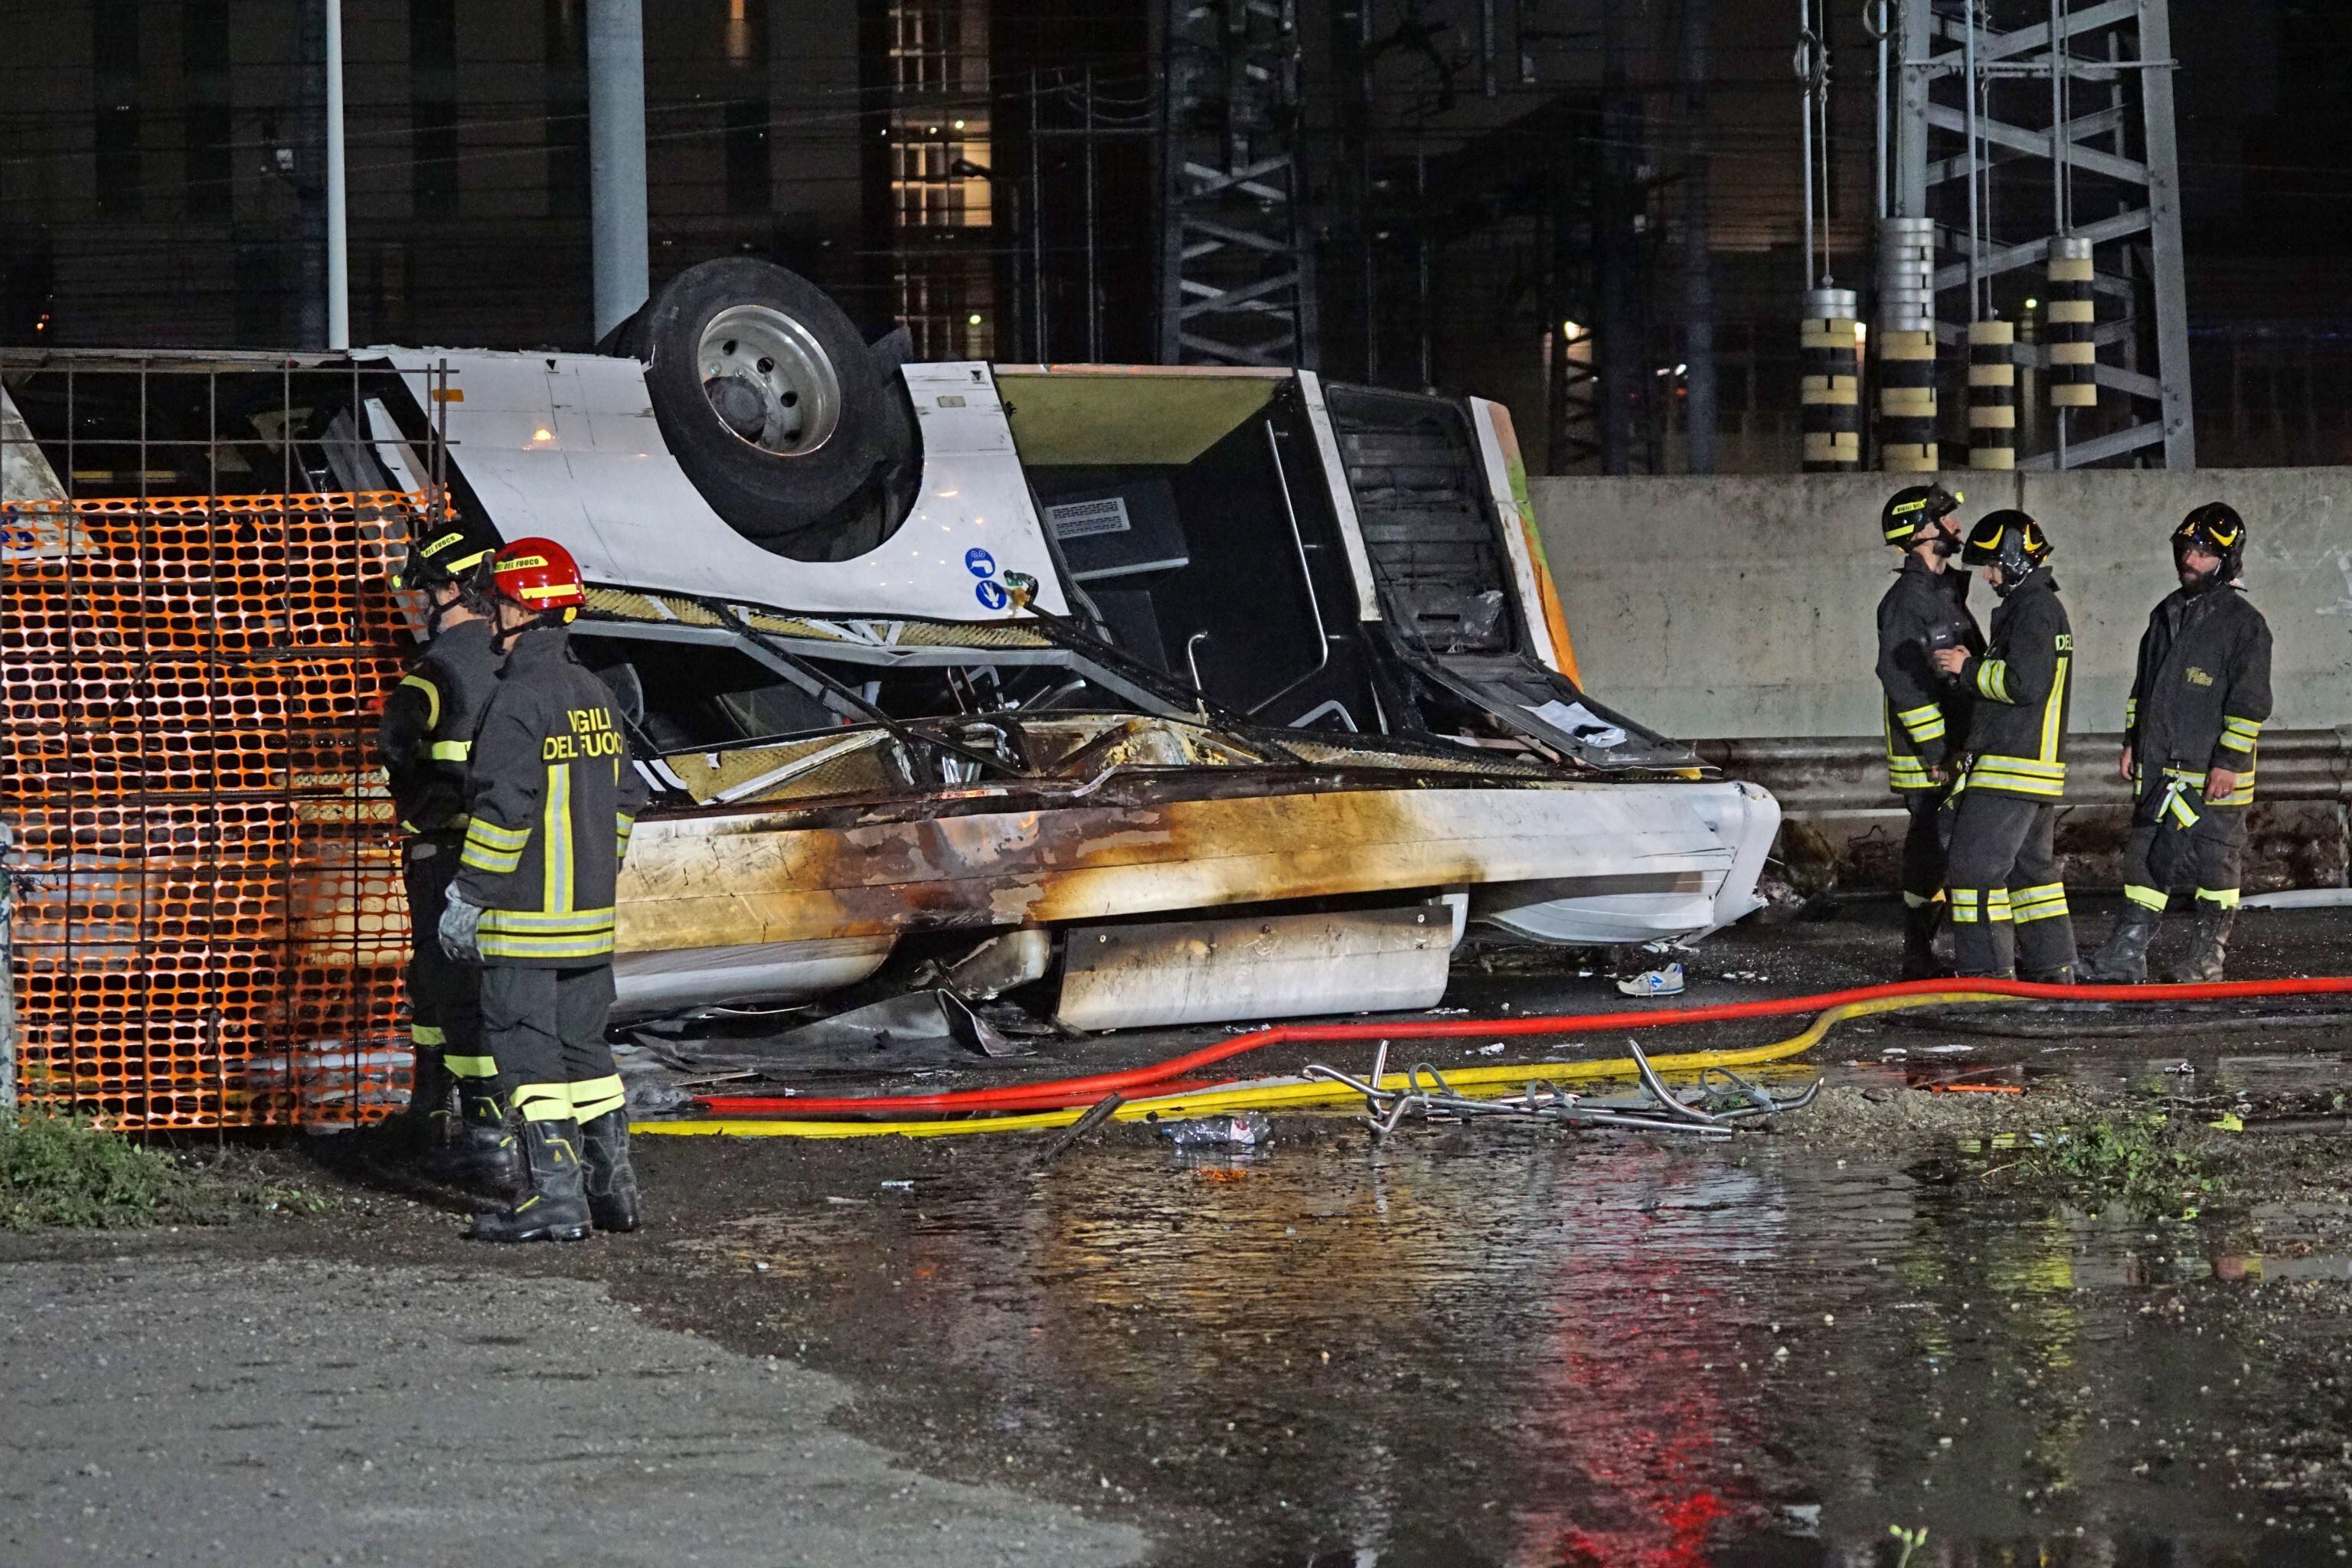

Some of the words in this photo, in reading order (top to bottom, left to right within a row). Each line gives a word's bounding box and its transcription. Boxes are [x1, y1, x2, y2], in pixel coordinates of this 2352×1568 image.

[425, 547, 434, 556] DEL
[435, 536, 455, 550] FUOCO
[504, 561, 514, 570] DEL
[516, 558, 539, 567] FUOCO
[2055, 634, 2073, 651] DEL
[567, 707, 612, 733] VGILI
[543, 736, 578, 760] DEL
